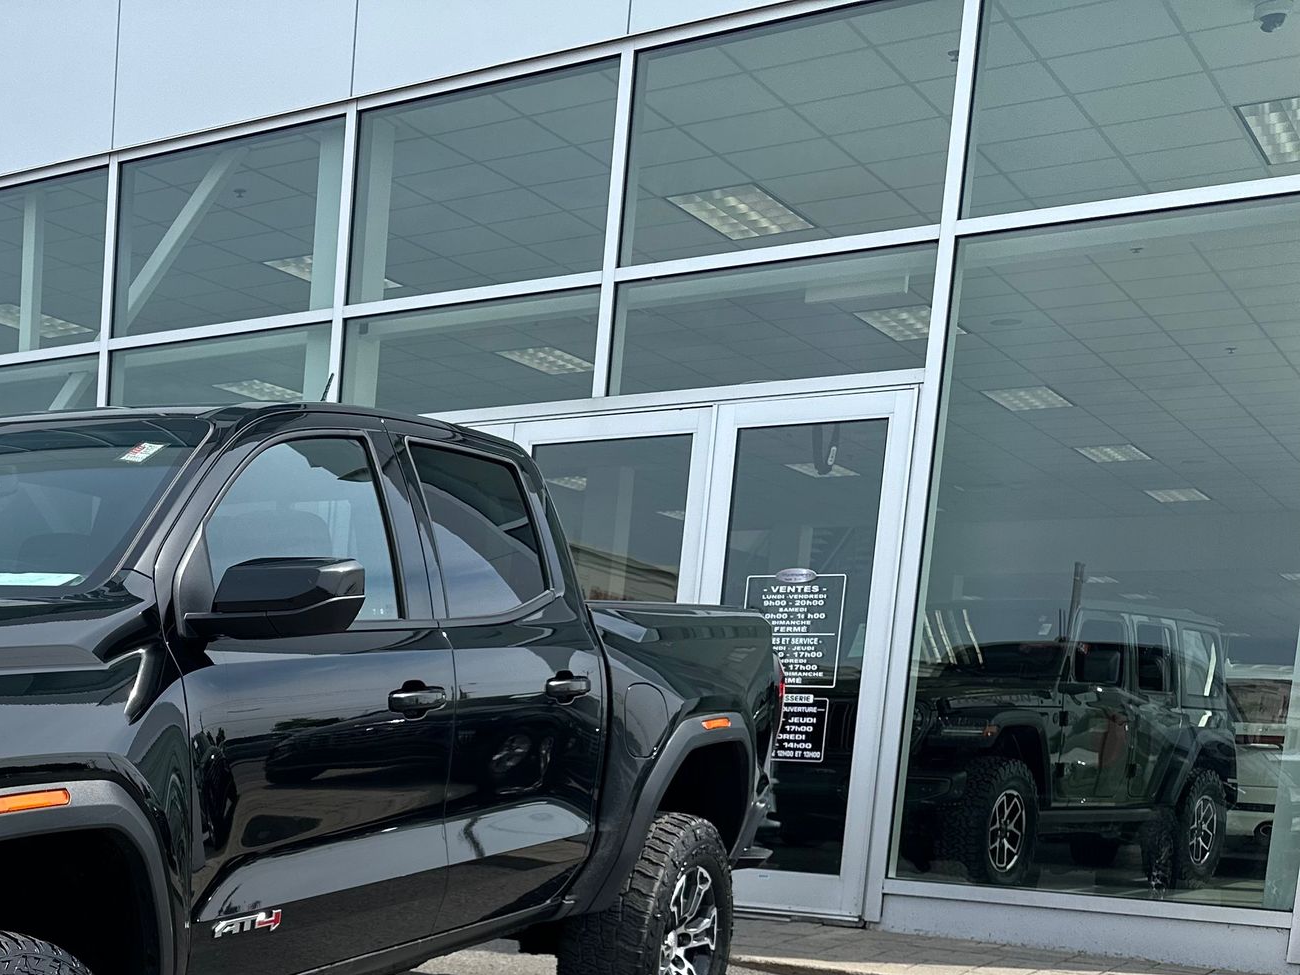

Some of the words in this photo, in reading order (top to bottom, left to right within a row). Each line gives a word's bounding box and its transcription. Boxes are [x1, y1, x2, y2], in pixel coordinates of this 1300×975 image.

[771, 585, 820, 593] VENTES
[781, 637, 790, 645] ET
[791, 637, 818, 645] SERVICE
[782, 742, 812, 750] 14h00
[795, 750, 802, 758] ET
[212, 909, 282, 938] AT4
